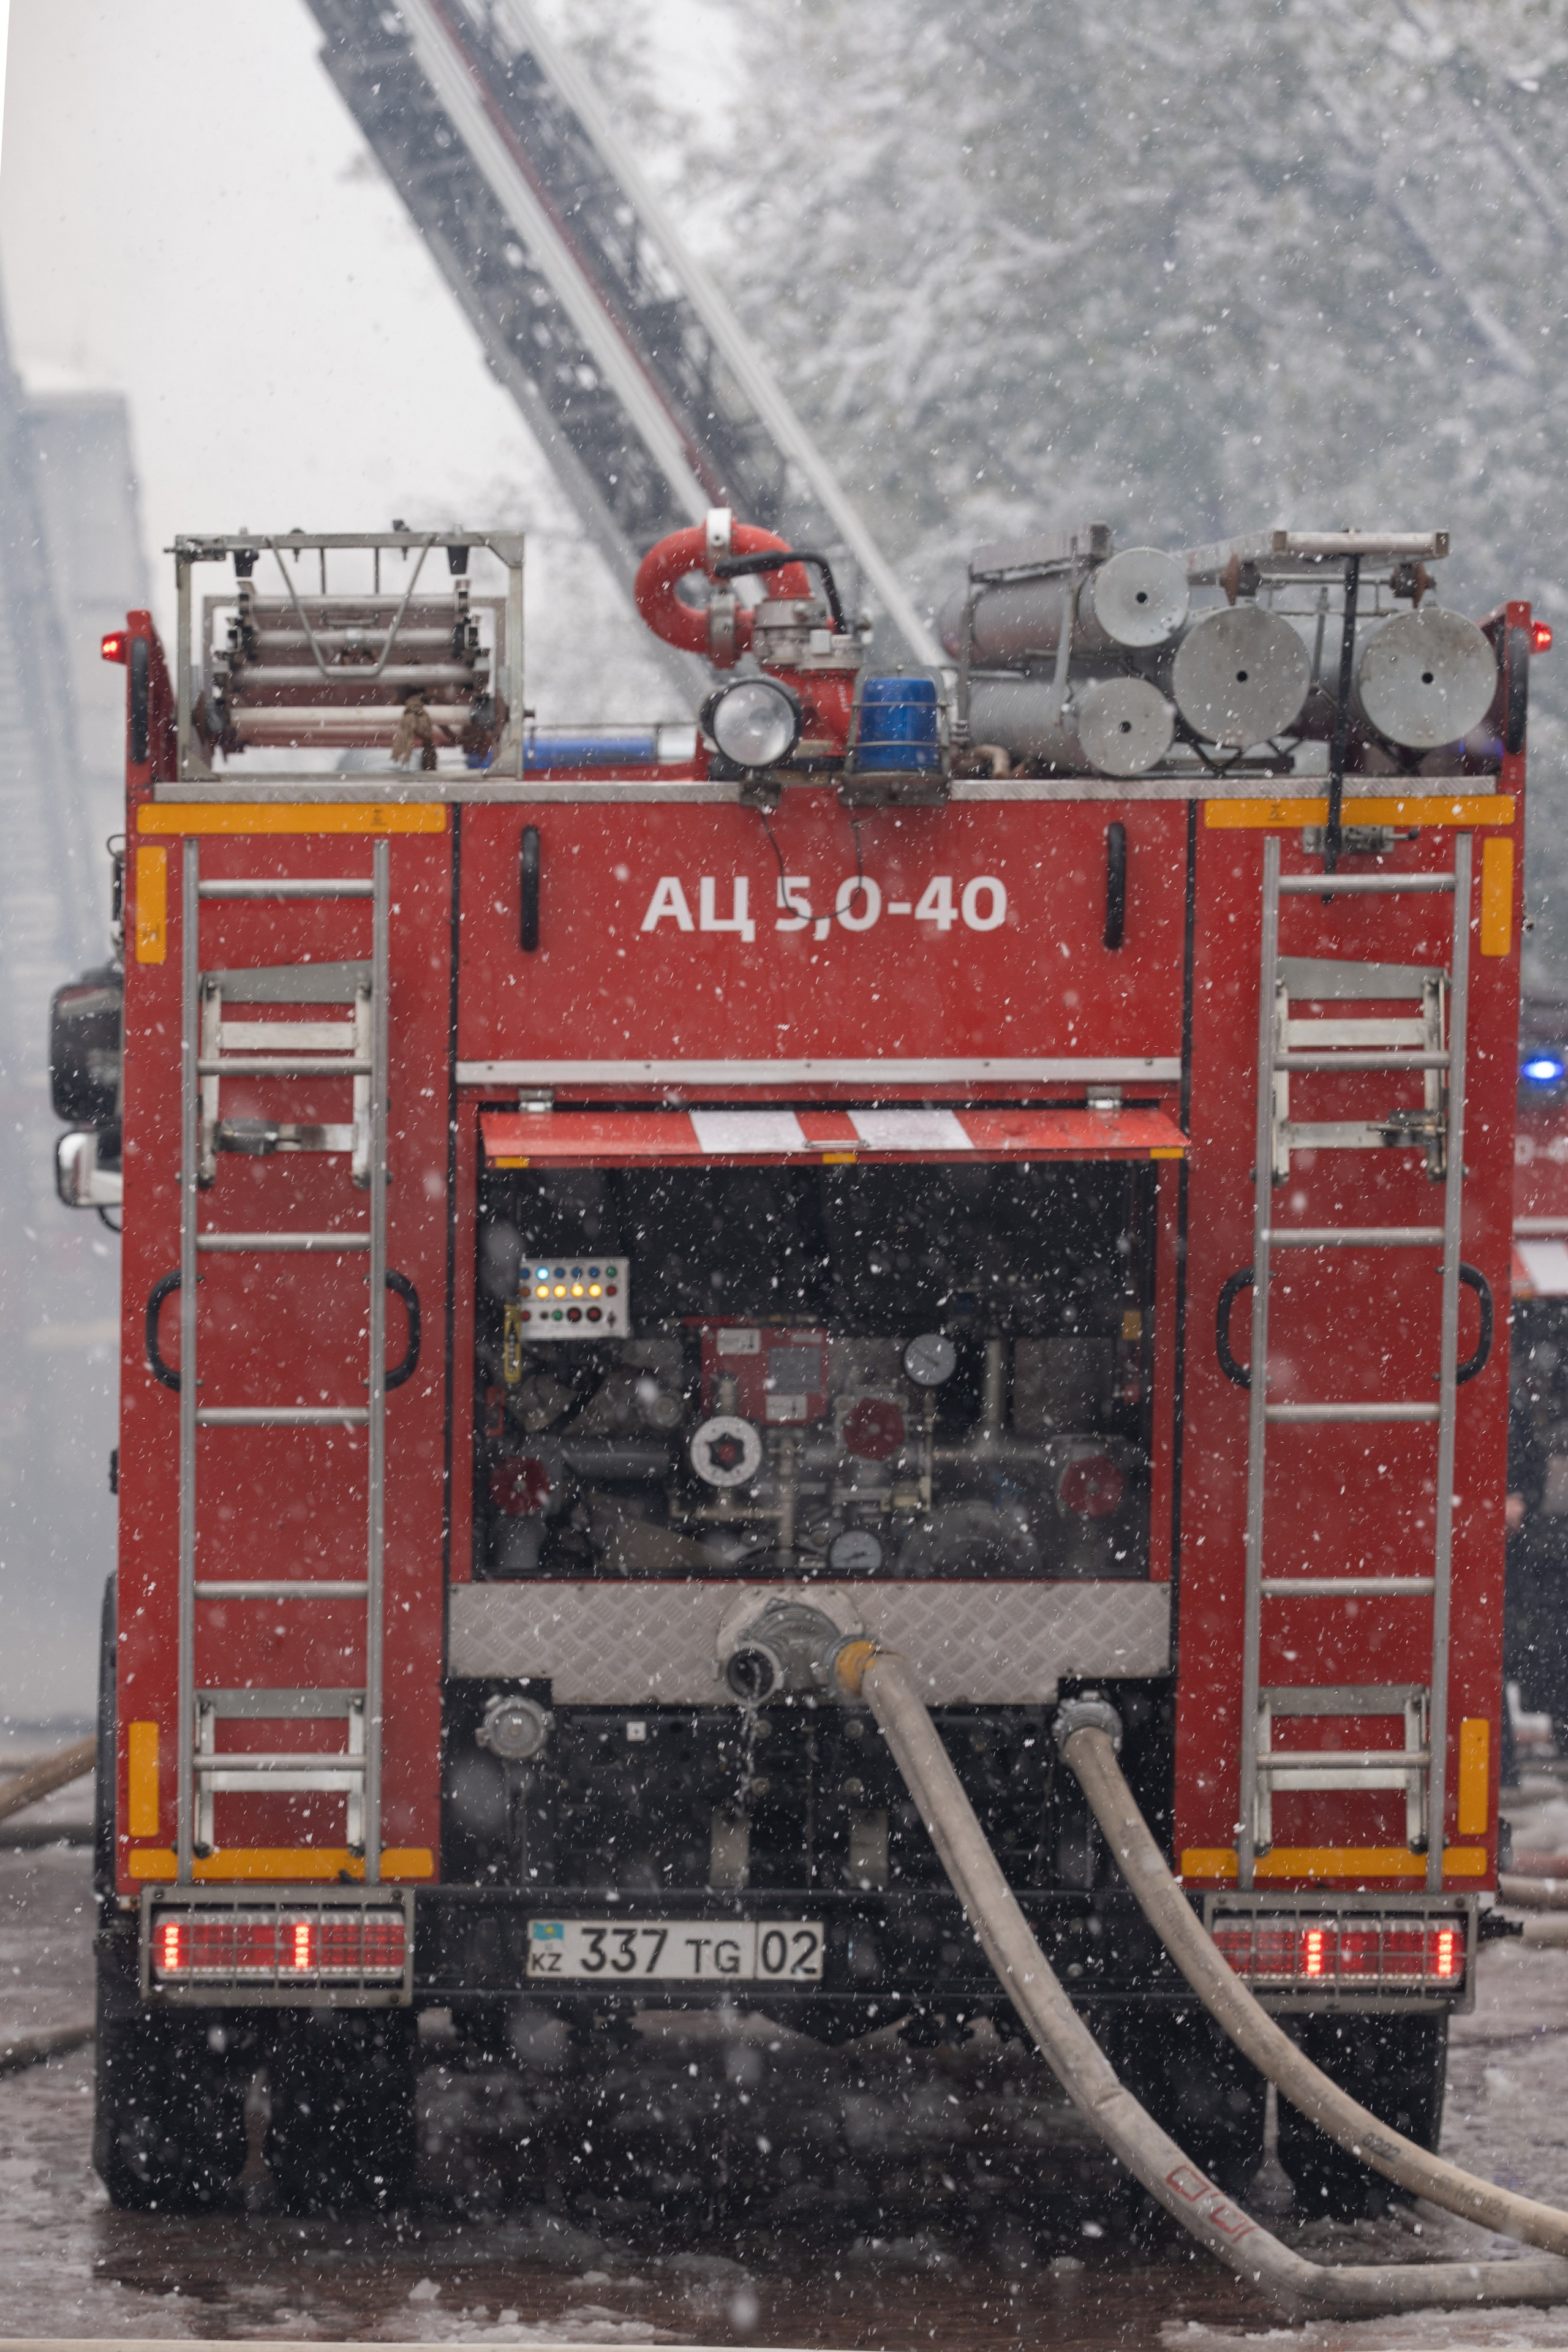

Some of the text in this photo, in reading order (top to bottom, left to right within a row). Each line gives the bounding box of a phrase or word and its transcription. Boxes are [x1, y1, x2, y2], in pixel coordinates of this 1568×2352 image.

[640, 875, 1008, 943] АЦ 5,0-40
[532, 1953, 562, 1972] KZ
[580, 1928, 818, 1974] 337 TG 02
